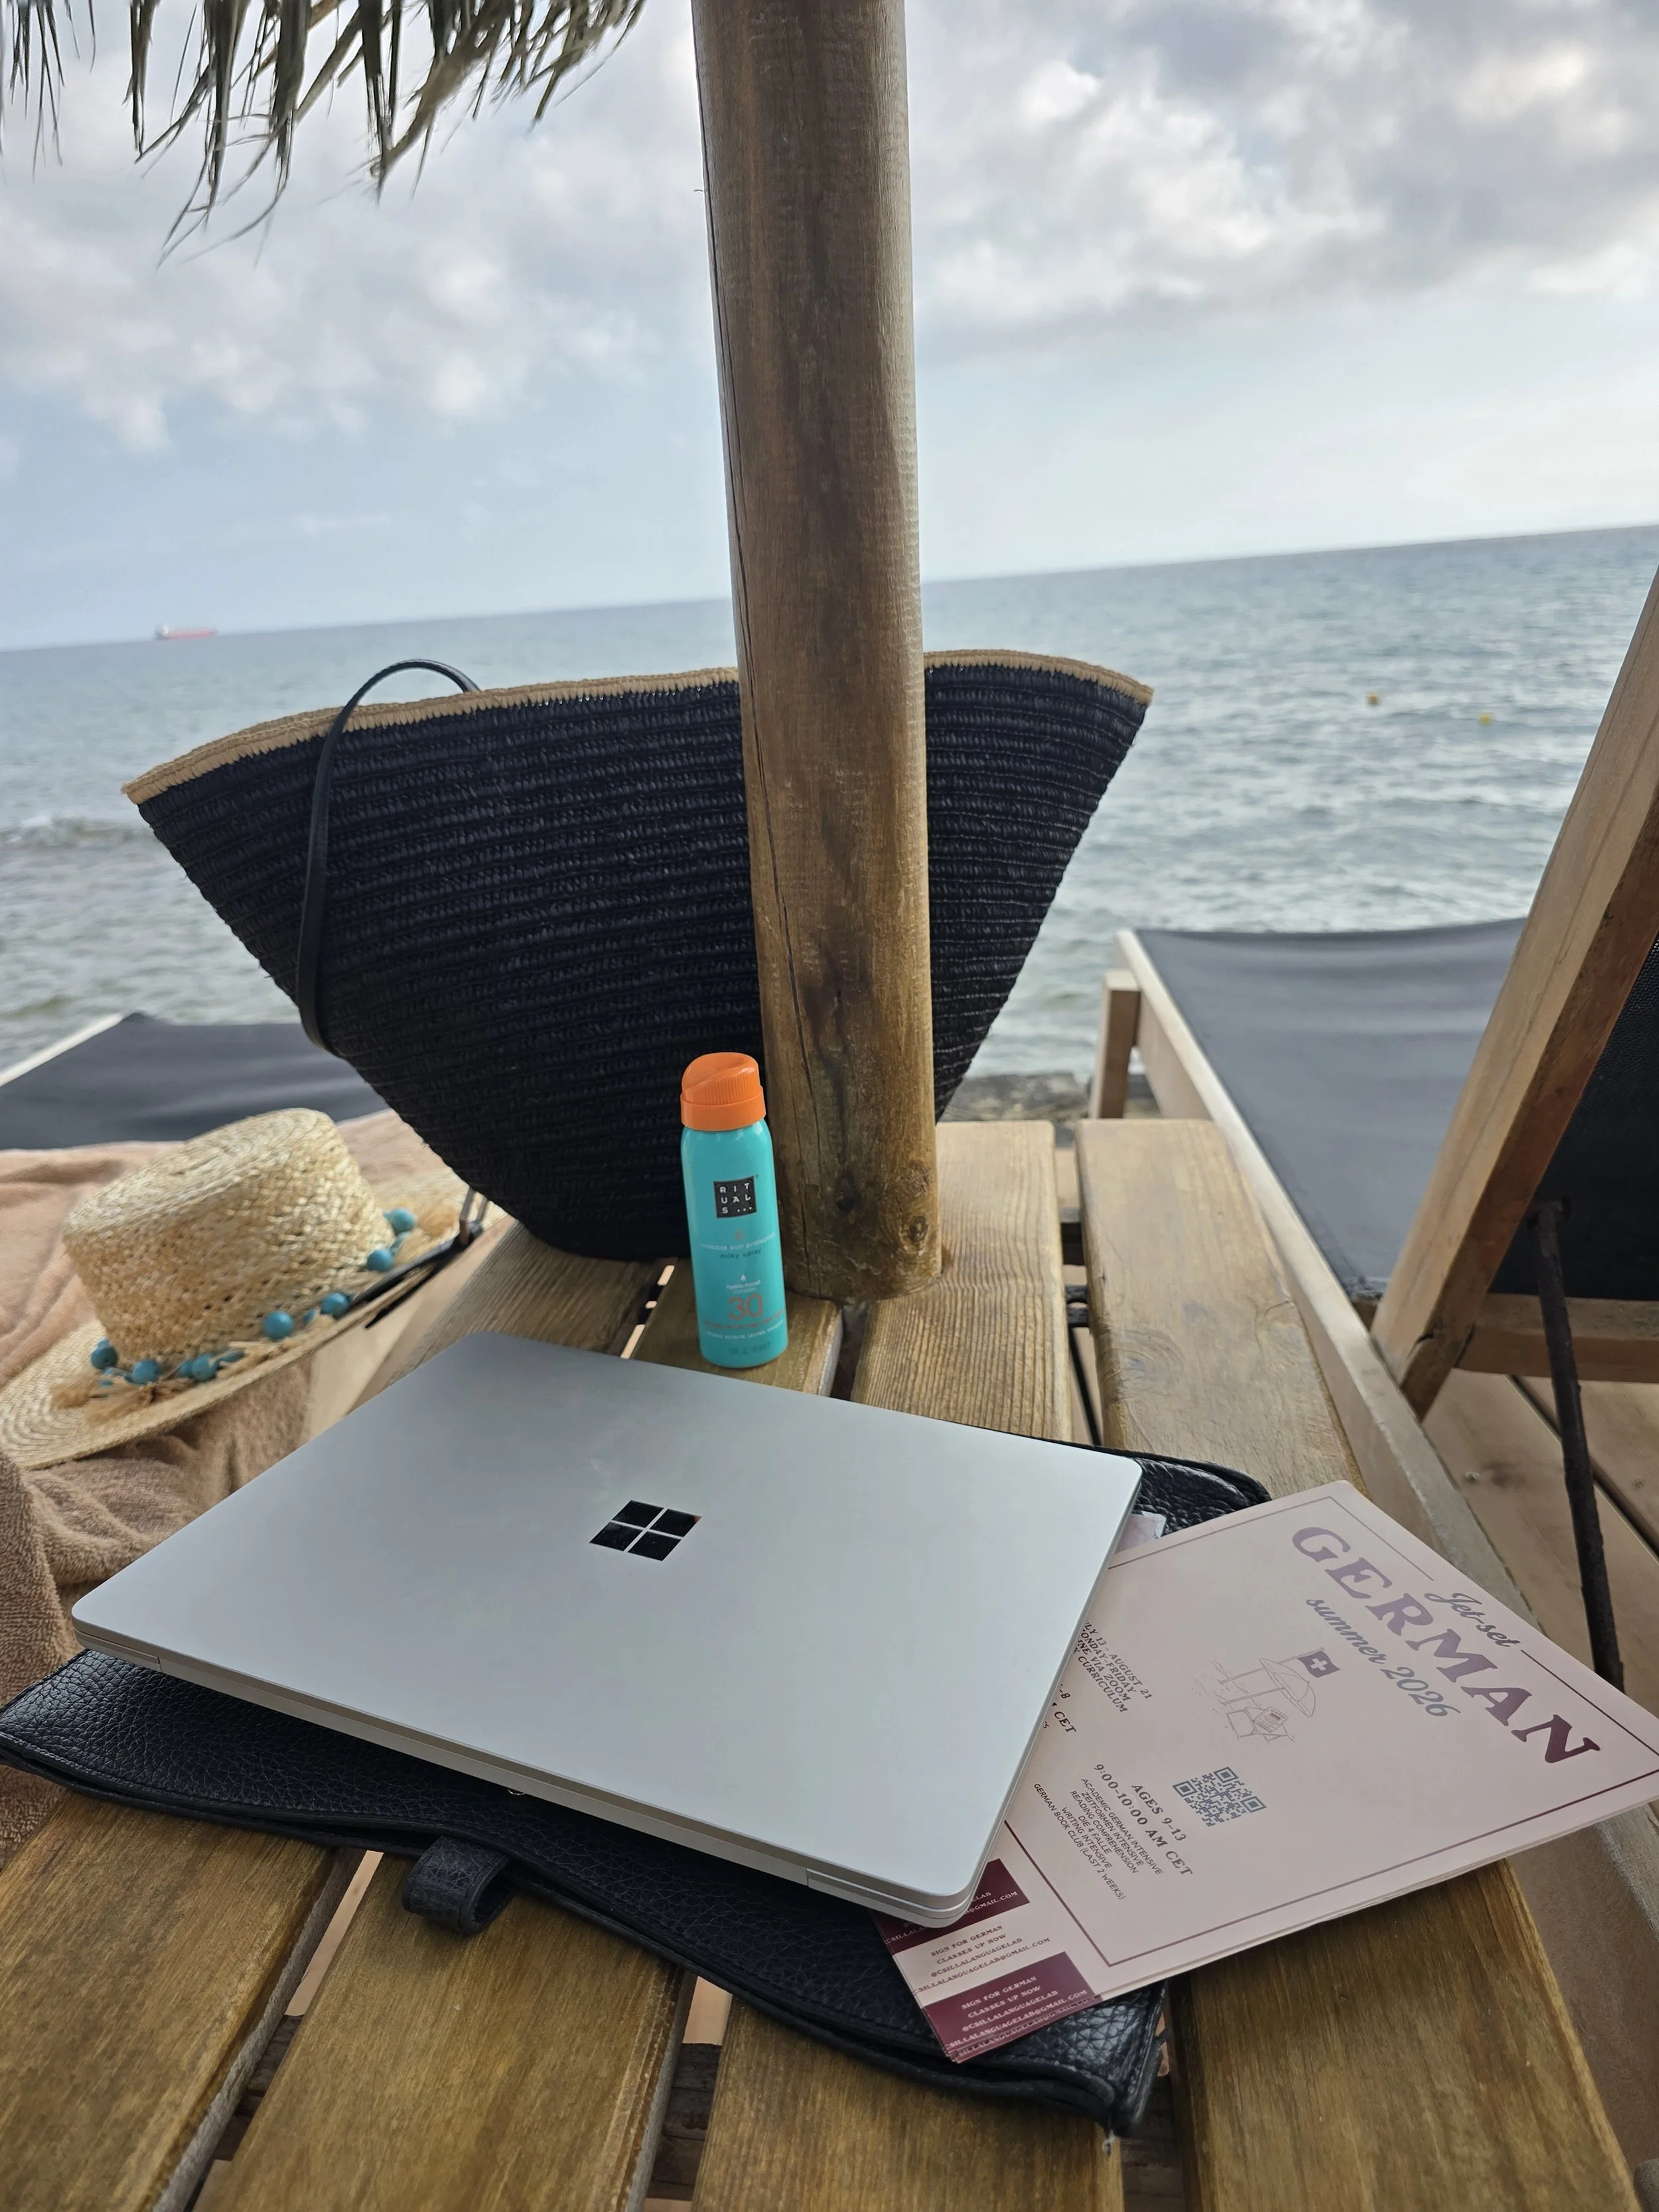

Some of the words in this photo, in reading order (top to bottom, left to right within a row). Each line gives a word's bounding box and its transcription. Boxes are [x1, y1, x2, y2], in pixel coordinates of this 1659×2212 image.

[728, 1293, 764, 1320] 30
[1292, 1527, 1601, 1763] GERMAN
[1423, 1593, 1521, 1648] Jet-set
[1078, 1657, 1128, 1712] CURRICULUM
[1081, 1629, 1137, 1692] ONDAY-FRIDAY
[1084, 1621, 1099, 1635] LY
[1109, 1654, 1143, 1686] AUGUST
[1140, 1688, 1152, 1699] 21
[1090, 1657, 1105, 1672] VIA
[1103, 1674, 1131, 1701] ZOOM
[1306, 1599, 1387, 1664] summer
[1380, 1666, 1461, 1717] 2026
[1054, 1711, 1076, 1732] CET
[1062, 1807, 1085, 1834] WRITING
[1082, 1834, 1113, 1869] INTENSIVE
[1070, 1791, 1095, 1819] READING
[1092, 1820, 1139, 1873] COMPREHENSION
[1078, 1815, 1090, 1827] DIE
[1092, 1833, 1112, 1854] FALLE
[1081, 1779, 1111, 1812] ACADEMIC
[1108, 1812, 1134, 1840] GERMAN
[1131, 1840, 1163, 1875] INTENSIVE
[1081, 1791, 1116, 1832] ZEITFORMEN
[1113, 1832, 1145, 1866] INTENSIVE
[1094, 1764, 1148, 1825] 9:00-10:00
[1145, 1830, 1168, 1848] AM
[1165, 1850, 1192, 1874] CET
[1131, 1785, 1163, 1814] AGES
[1161, 1817, 1187, 1841] 9-13
[1034, 1783, 1057, 1811] GERMAN
[1054, 1811, 1070, 1830] BOOK
[1068, 1830, 1084, 1848] CLUB
[1080, 1848, 1102, 1867] (LAST
[1102, 1874, 1126, 1900] WEEKS)
[930, 1946, 950, 1956] SIGN
[951, 1939, 968, 1949] FOR
[970, 1925, 1003, 1941] GERMAN
[936, 1947, 973, 1964] CLASSES
[987, 1933, 1007, 1945] NOW
[961, 1998, 981, 2010] SIGN
[983, 1990, 1001, 2001] FOR
[1002, 1976, 1037, 1994] GERMAN
[967, 2000, 1006, 2018] CLASSES
[1007, 1994, 1019, 2003] UP
[1021, 1985, 1041, 1998] NOW
